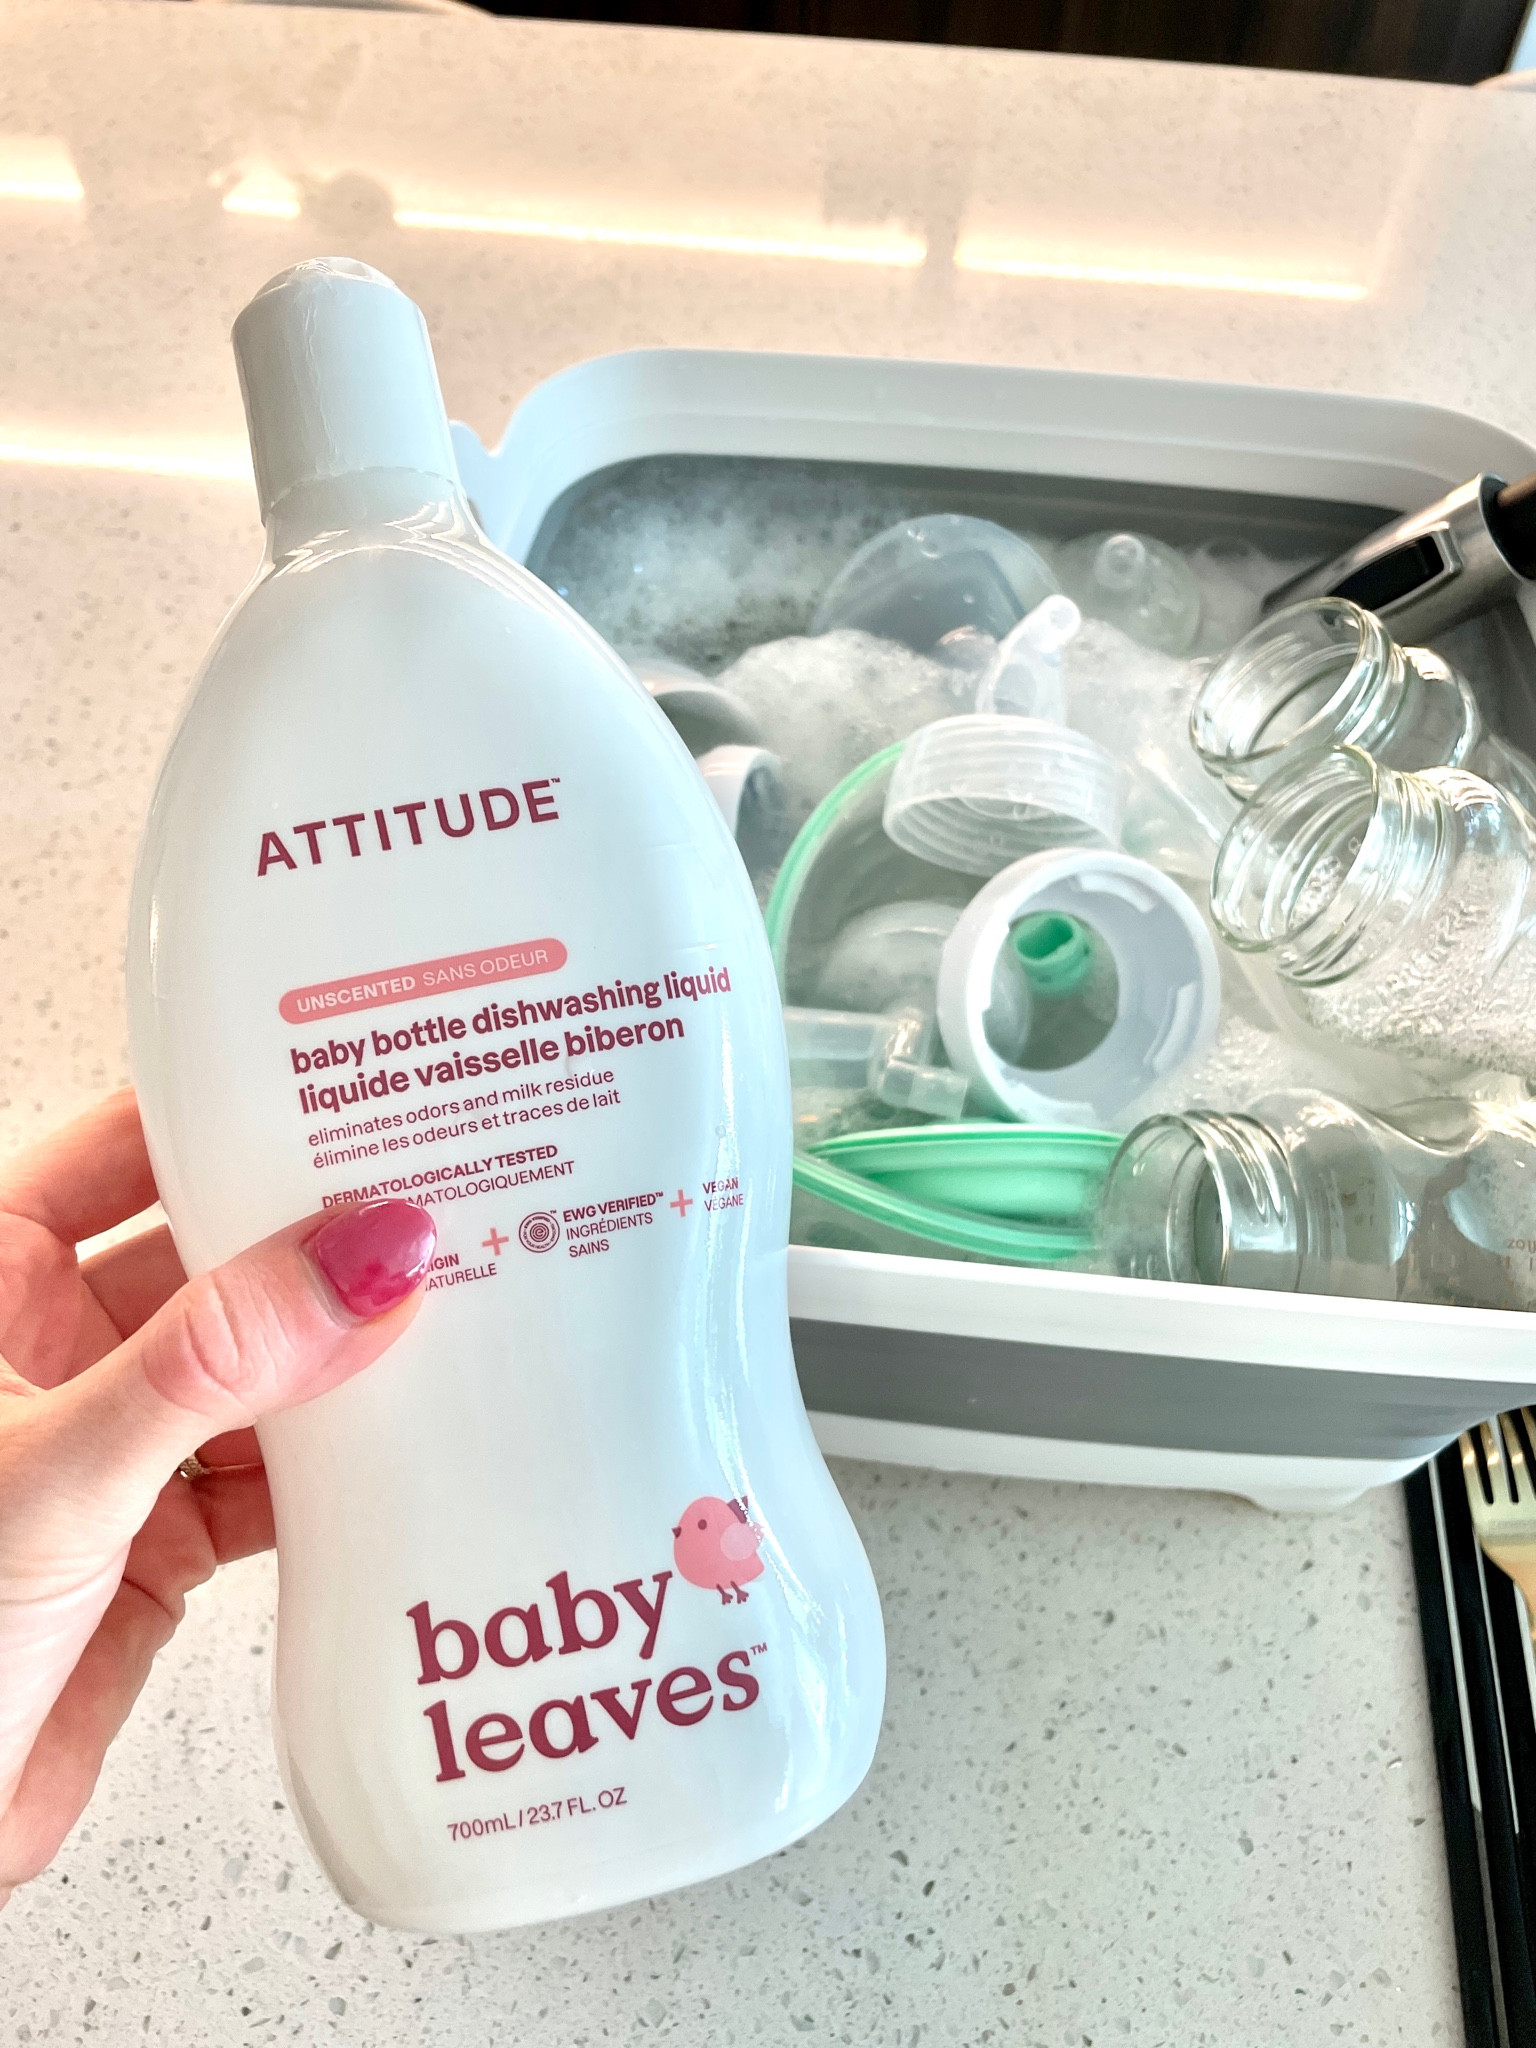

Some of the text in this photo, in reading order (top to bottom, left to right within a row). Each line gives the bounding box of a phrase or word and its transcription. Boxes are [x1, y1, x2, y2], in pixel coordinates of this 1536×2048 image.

[297, 950, 548, 1012] UNSCENTED SANS ODEUR
[290, 966, 731, 1074] baby bottle dishwashing liquid
[299, 1018, 684, 1114] liquide vaisselle biberon
[308, 1071, 614, 1146] eliminates odors and milk residue
[313, 1089, 621, 1168] élimine les odeurs et traces de lait
[322, 1145, 558, 1208] DERMATOLOGICALLY TESTED
[408, 1160, 575, 1207] MATOLOGIQUEMENT
[702, 1177, 738, 1195] VEGAN
[563, 1205, 596, 1223] EWG
[566, 1212, 653, 1240] INGRÉDIENTS
[428, 1253, 460, 1272] IGIN
[569, 1239, 609, 1258] SAINS
[425, 1263, 497, 1291] ATURELLE
[406, 1570, 673, 1685] baby
[447, 1813, 516, 1841] 700mL
[527, 1801, 562, 1825] 23.7
[567, 1797, 596, 1816] FL.
[598, 1787, 627, 1808] OZ
